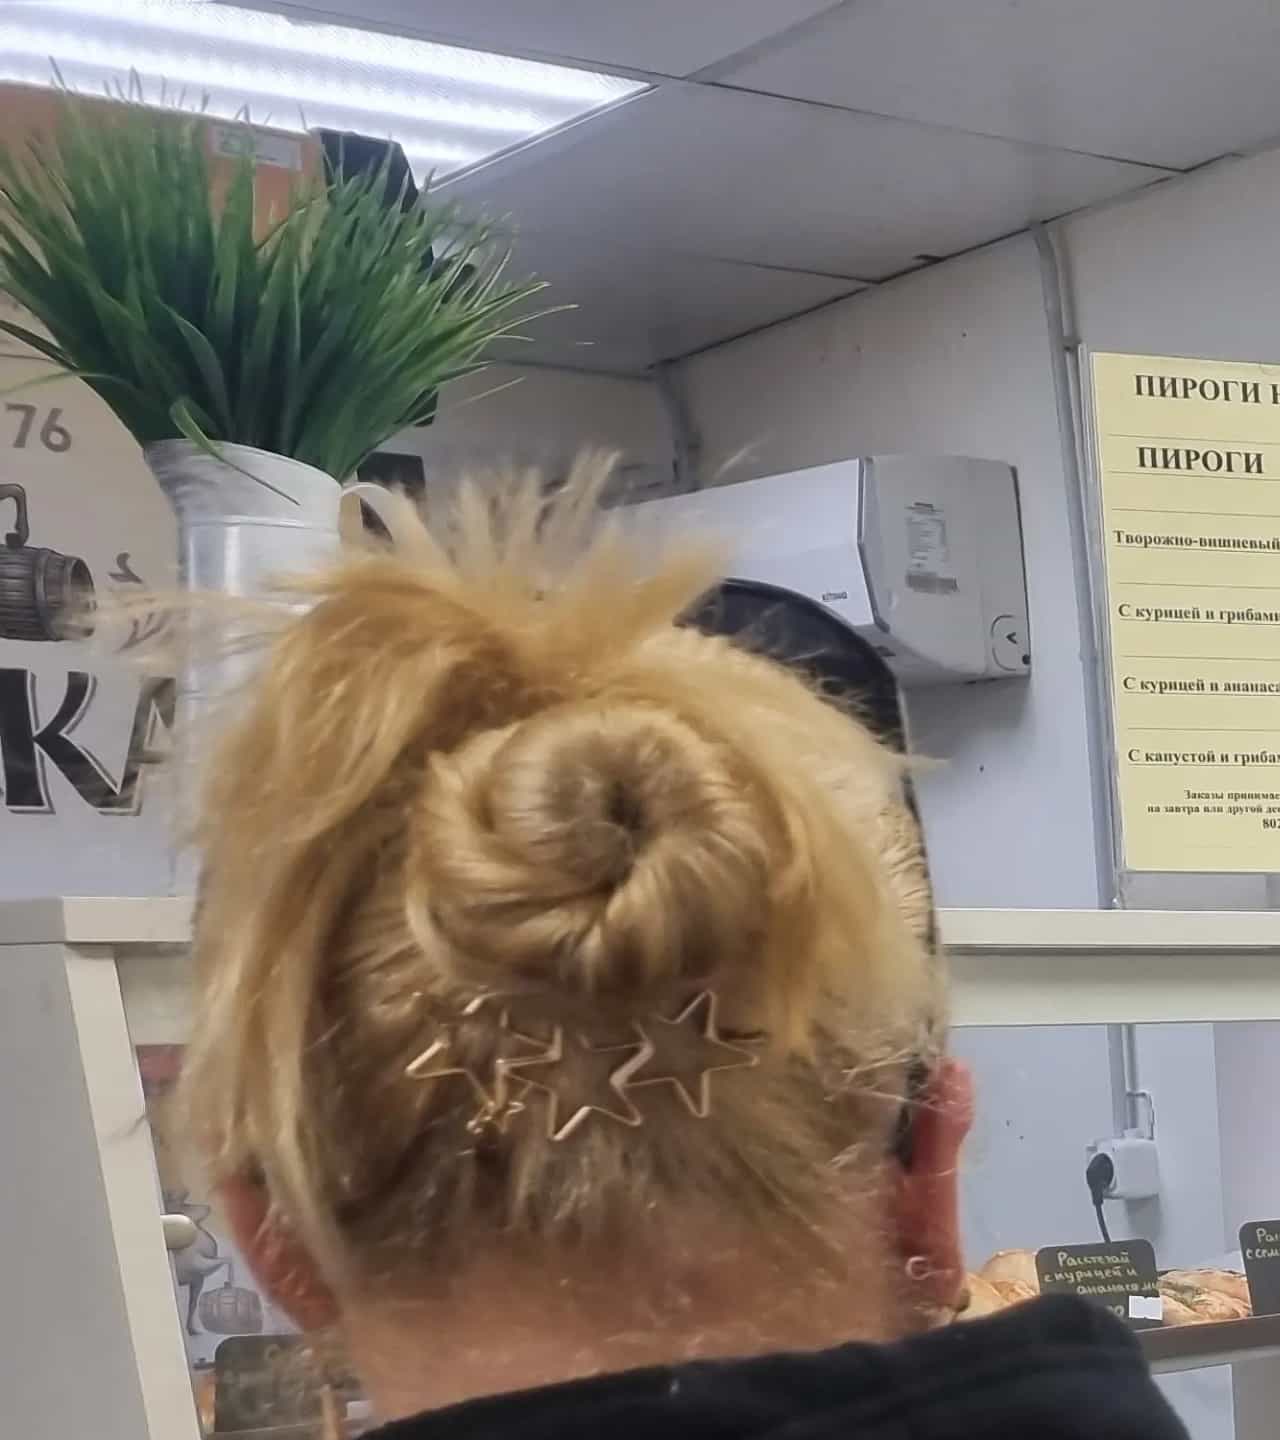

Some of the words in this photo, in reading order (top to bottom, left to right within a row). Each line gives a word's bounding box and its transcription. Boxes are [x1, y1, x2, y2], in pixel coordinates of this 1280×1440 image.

[1135, 374, 1260, 404] ПИРОГИ
[1136, 446, 1264, 474] ПИРОГИ
[1113, 530, 1280, 550] Творожно-вишневый
[1118, 603, 1131, 617] С
[1135, 606, 1201, 622] курицей
[1205, 610, 1215, 620] и
[1123, 676, 1136, 690] С
[1140, 679, 1205, 694] курицей
[1209, 681, 1219, 691] и
[1128, 749, 1140, 762] С
[1145, 751, 1215, 765] капустой
[1220, 753, 1229, 763] и
[1184, 790, 1224, 800] Заказы
[1147, 805, 1160, 813] на
[1165, 805, 1200, 815] завтра
[1203, 805, 1223, 813] или
[1227, 804, 1263, 815] другой
